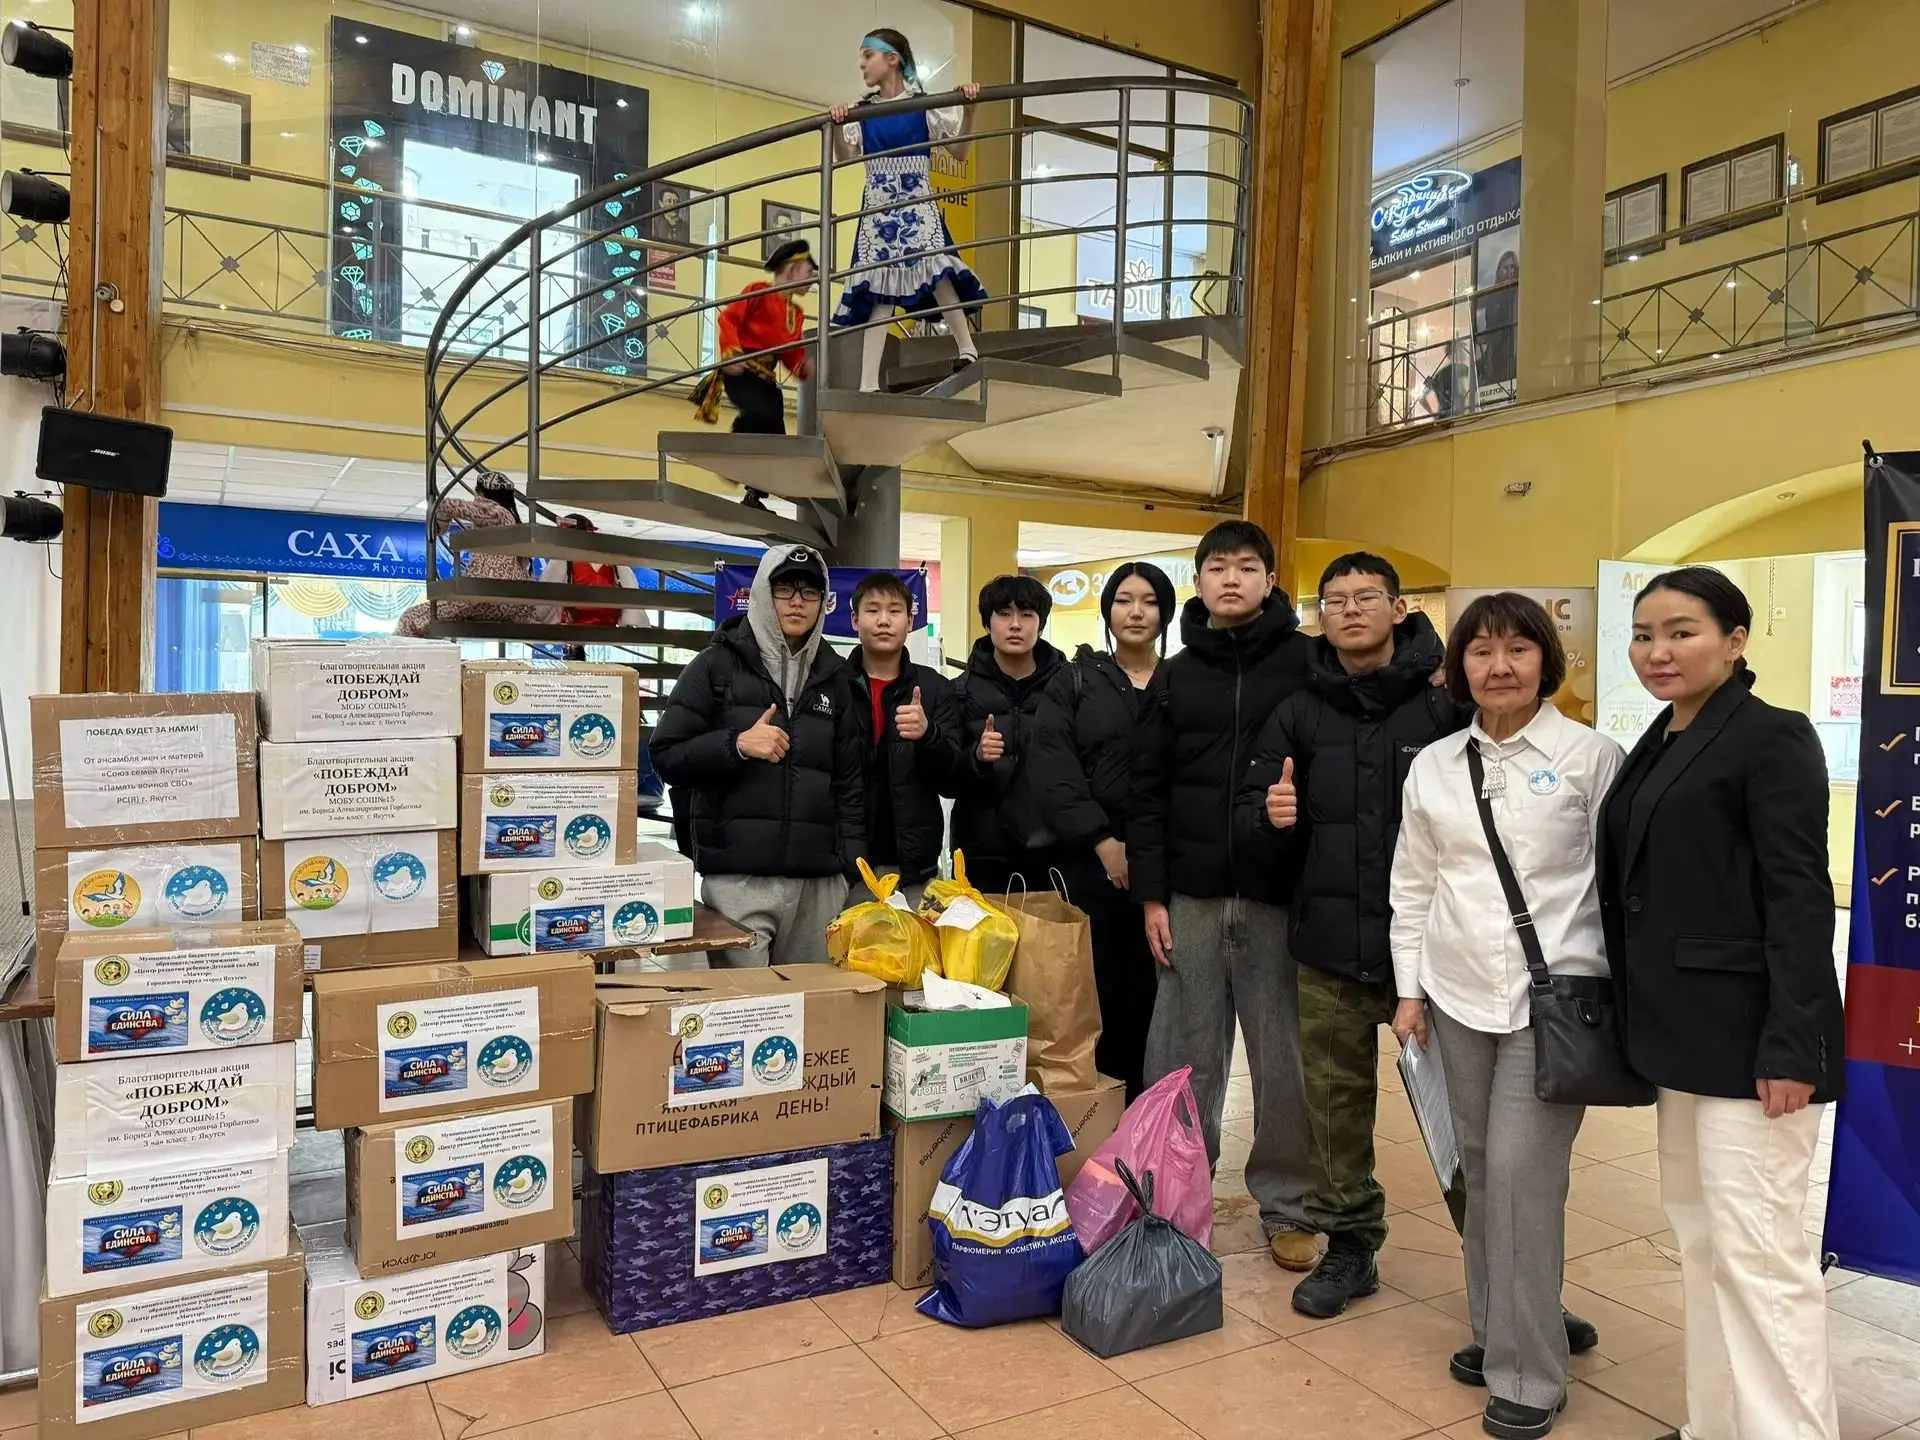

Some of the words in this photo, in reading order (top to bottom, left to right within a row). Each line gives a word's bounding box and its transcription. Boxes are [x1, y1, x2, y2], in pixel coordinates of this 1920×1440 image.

[392, 62, 598, 144] DOMINANT
[1370, 251, 1402, 269] БАЛКИ
[1405, 248, 1412, 256] И
[1414, 226, 1474, 254] АКТИВНОГО
[1476, 208, 1520, 231] ОТДЫХА
[91, 448, 119, 457] BOSE
[288, 530, 402, 562] САХА
[372, 562, 427, 577] Якутск
[320, 662, 399, 671] Благотворительная
[401, 662, 425, 670] акция
[326, 672, 420, 686] «ПОБЕЖДАЙ
[338, 690, 408, 702] ДОБРОМ»
[813, 704, 832, 715] CAMEL
[86, 728, 122, 736] ПОБЕДА
[126, 727, 152, 735] БУДЕТ
[169, 725, 199, 733] НАМИ!
[98, 755, 138, 764] ансамбля
[169, 752, 203, 760] матерей
[308, 757, 388, 765] Благотворительная
[390, 756, 413, 764] акция
[102, 770, 128, 778] «Союз
[160, 767, 189, 775] Якутии
[313, 765, 408, 780] «ПОБЕЖДАЙ
[99, 783, 136, 792] «Память
[138, 781, 168, 790] воинов
[171, 780, 192, 788] СВО»
[325, 782, 397, 797] ДОБРОМ»
[356, 796, 394, 804] СОШ№15
[551, 927, 583, 935] ЕДИНСТВА
[120, 1011, 151, 1020] СИЛА
[112, 1020, 157, 1030] ЕДИНСТВА
[696, 1058, 718, 1067] СИЛА
[804, 1049, 849, 1067] ЕЖЕЕ
[410, 1060, 436, 1070] СИЛА
[690, 1065, 722, 1074] ЕДИНСТВА
[118, 1065, 217, 1085] Благотворительная
[220, 1062, 250, 1074] акция
[404, 1067, 441, 1078] ЕДИНСТВА
[125, 1075, 243, 1100] «ПОБЕЖДАЙ
[140, 1097, 228, 1119] ДОБРОМ»
[776, 1098, 828, 1119] ДЕНЬ!
[145, 1117, 175, 1129] МОБУ
[178, 1112, 226, 1125] СОШ№15
[636, 1111, 759, 1135] ПТИЦЕФАБРИКА
[919, 1122, 956, 1166] wildberries
[428, 1183, 454, 1194] СИЛА
[421, 1191, 459, 1203] ЕДИНСТВА
[114, 1227, 145, 1239] СИЛА
[460, 1220, 509, 1235] подсолнечное
[721, 1227, 742, 1236] СИЛА
[436, 1229, 457, 1239] масло
[716, 1234, 747, 1245] ЕДИНСТВА
[106, 1237, 151, 1249] ЕДИНСТВА
[952, 1243, 1001, 1255] ПАРФЮМЕРИЯ
[1006, 1240, 1046, 1255] КОСМЕТИКА
[378, 1338, 404, 1349] СИЛА
[371, 1345, 409, 1360] ЕДИНСТВА
[114, 1359, 145, 1371] СИЛА
[105, 1367, 151, 1382] ЕДИНСТВА
